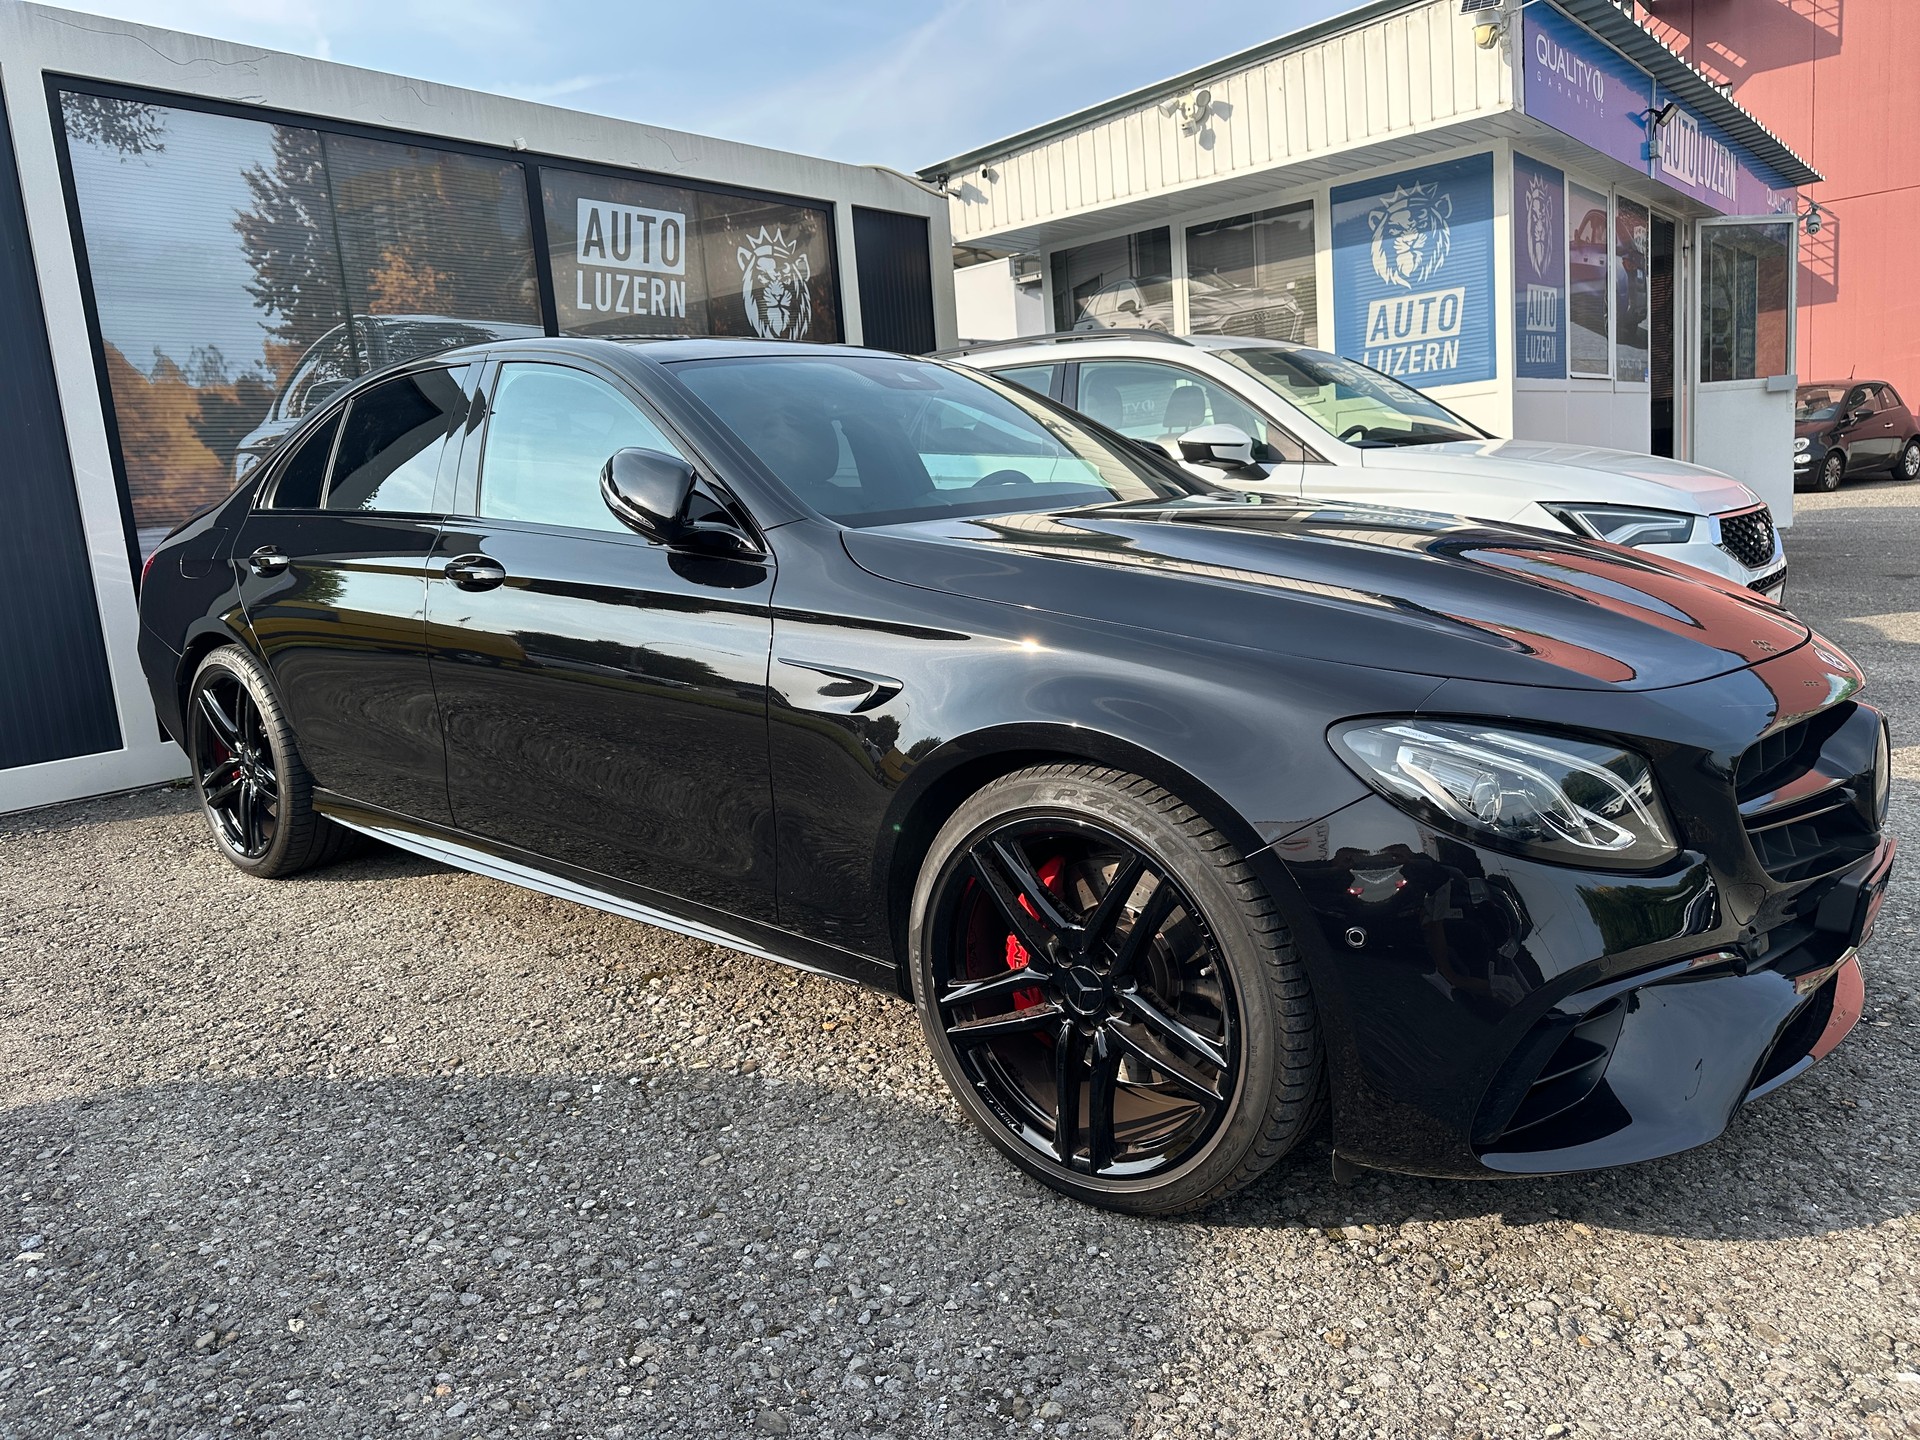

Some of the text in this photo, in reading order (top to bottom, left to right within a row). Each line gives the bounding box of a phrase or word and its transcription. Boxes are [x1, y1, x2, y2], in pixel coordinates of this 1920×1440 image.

[1536, 33, 1592, 93] QUALITY
[1536, 70, 1604, 118] GARANTIE
[1664, 112, 1736, 203] AUTO LUZERN
[583, 208, 680, 268] AUTO
[577, 270, 686, 318] LUZERN
[1370, 293, 1459, 342] AUTO
[1528, 289, 1556, 327] AUTO
[1525, 334, 1557, 363] LUZERN
